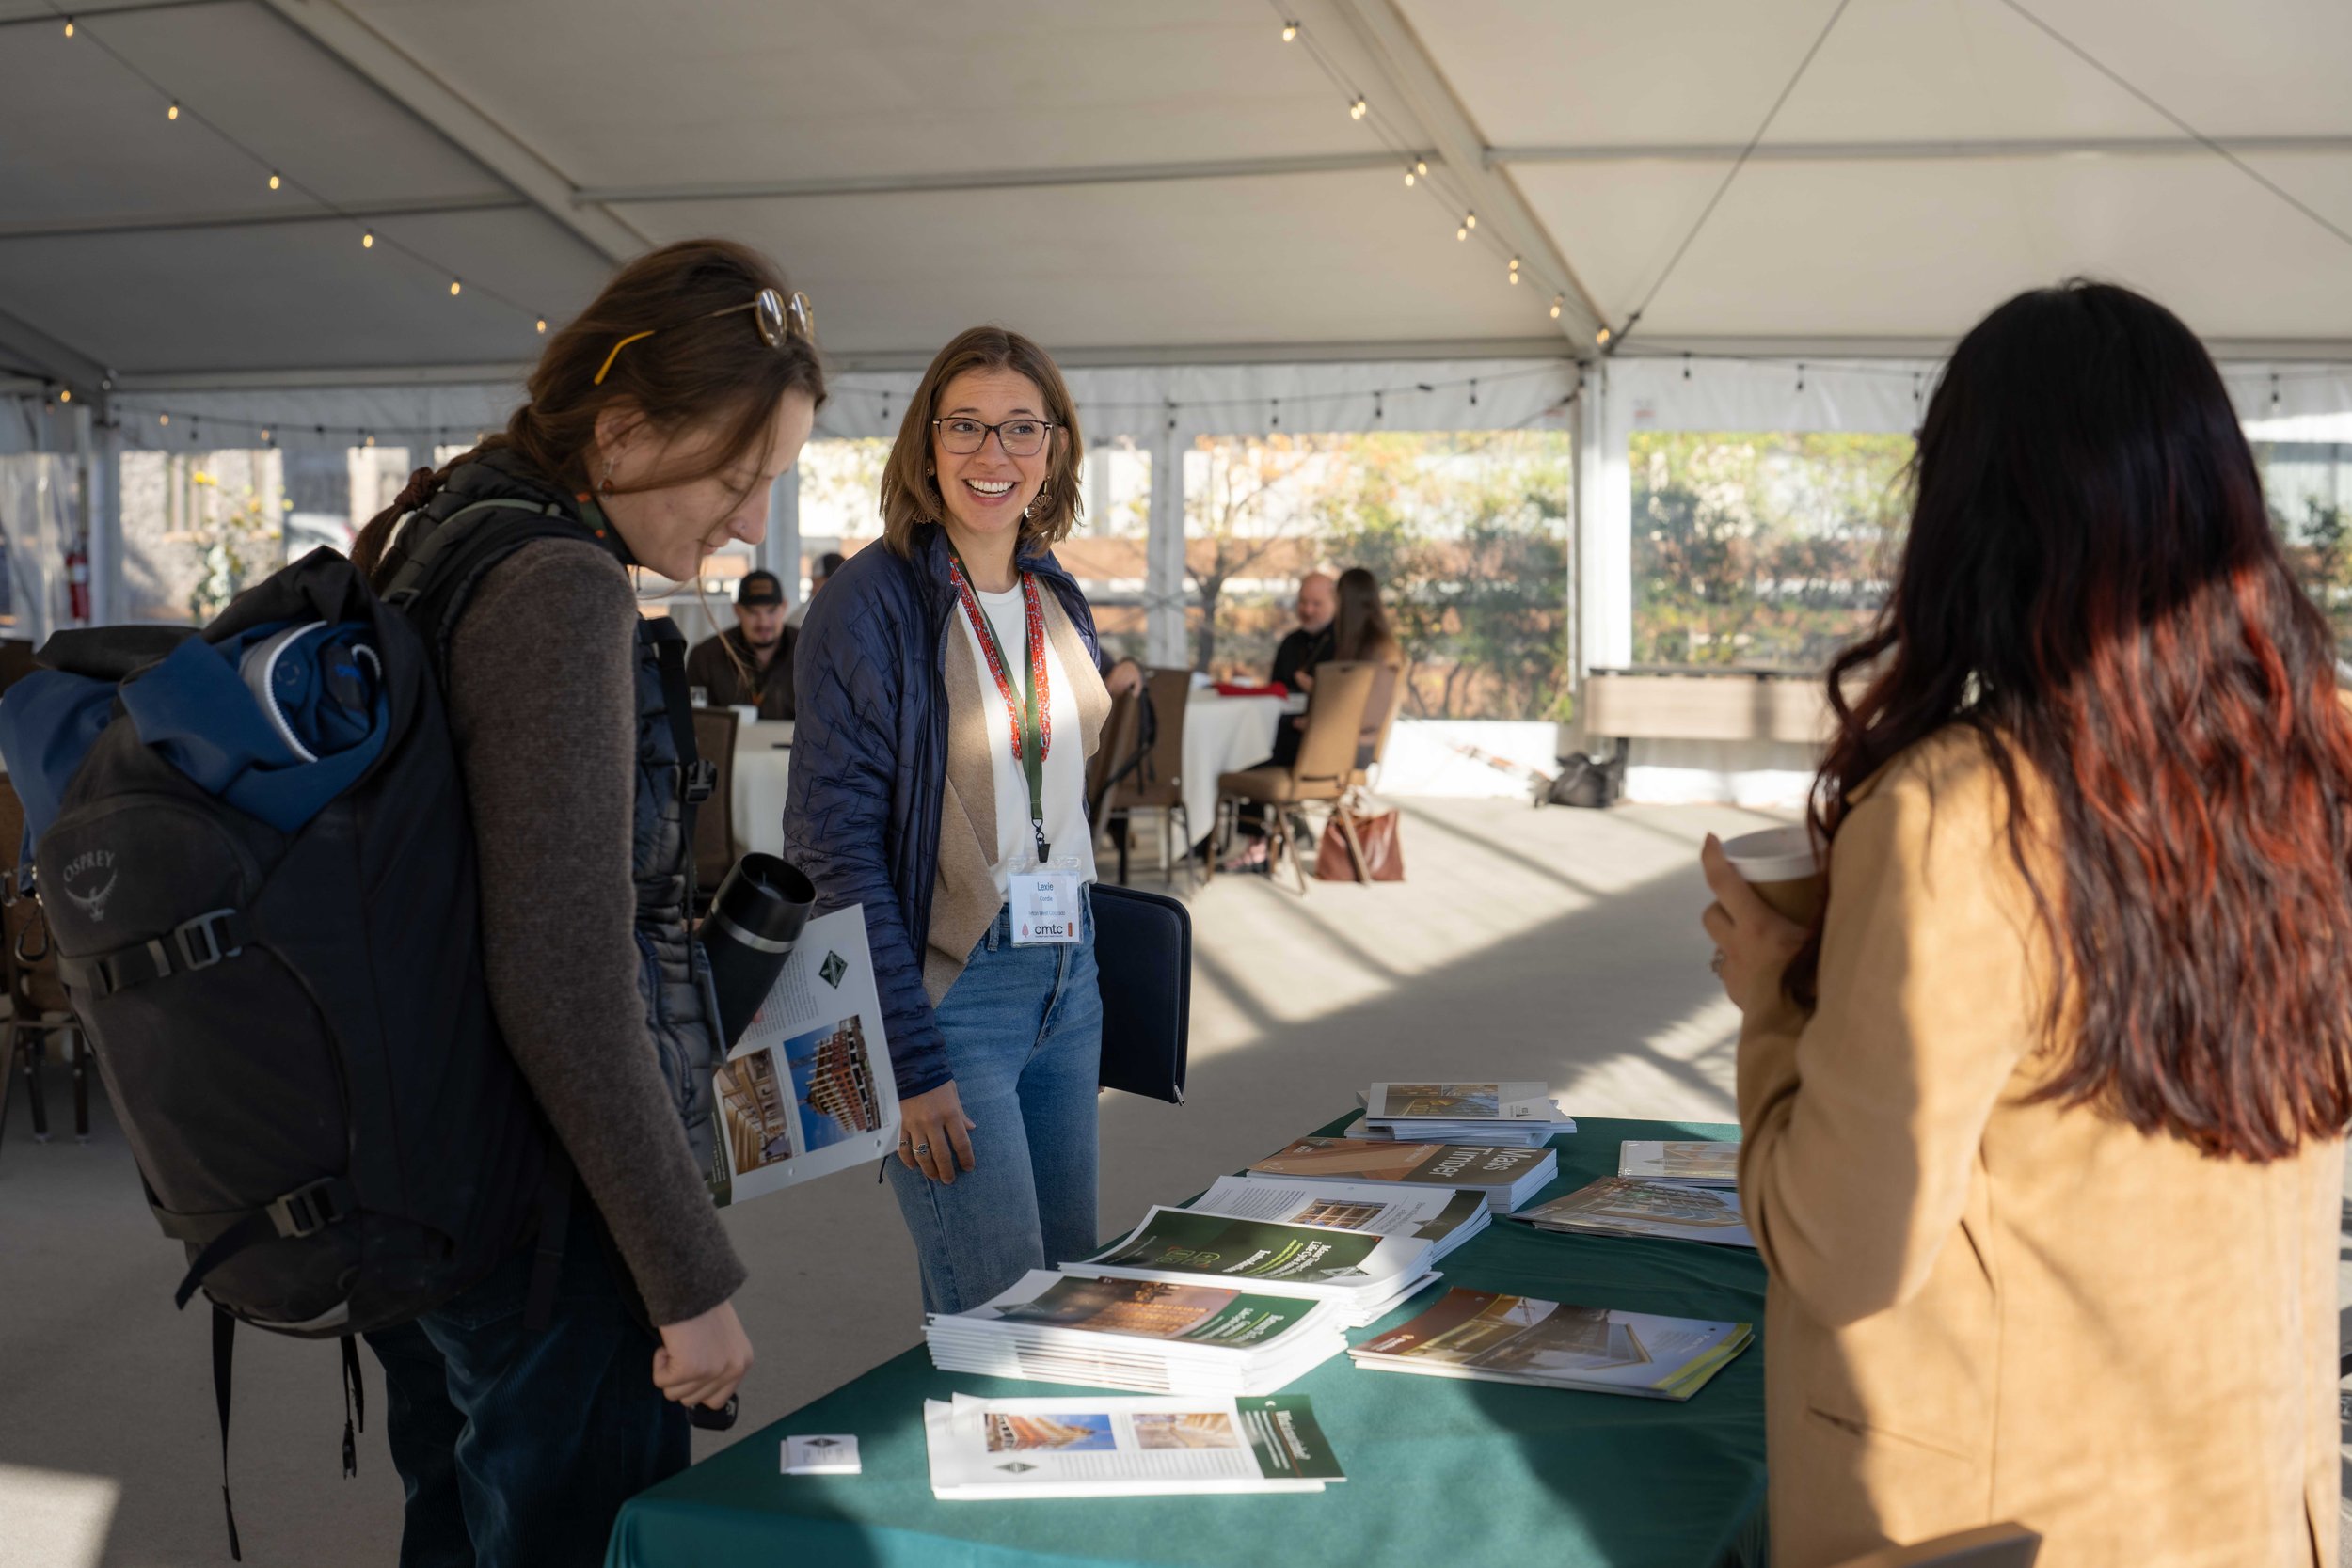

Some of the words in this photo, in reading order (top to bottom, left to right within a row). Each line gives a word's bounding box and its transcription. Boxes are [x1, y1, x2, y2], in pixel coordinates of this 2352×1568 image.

[63, 850, 115, 882] OSPREY
[1037, 882, 1054, 891] Lexie
[1035, 924, 1063, 934] cmtc
[1428, 1147, 1496, 1177] Timber
[1482, 1148, 1537, 1171] Mass
